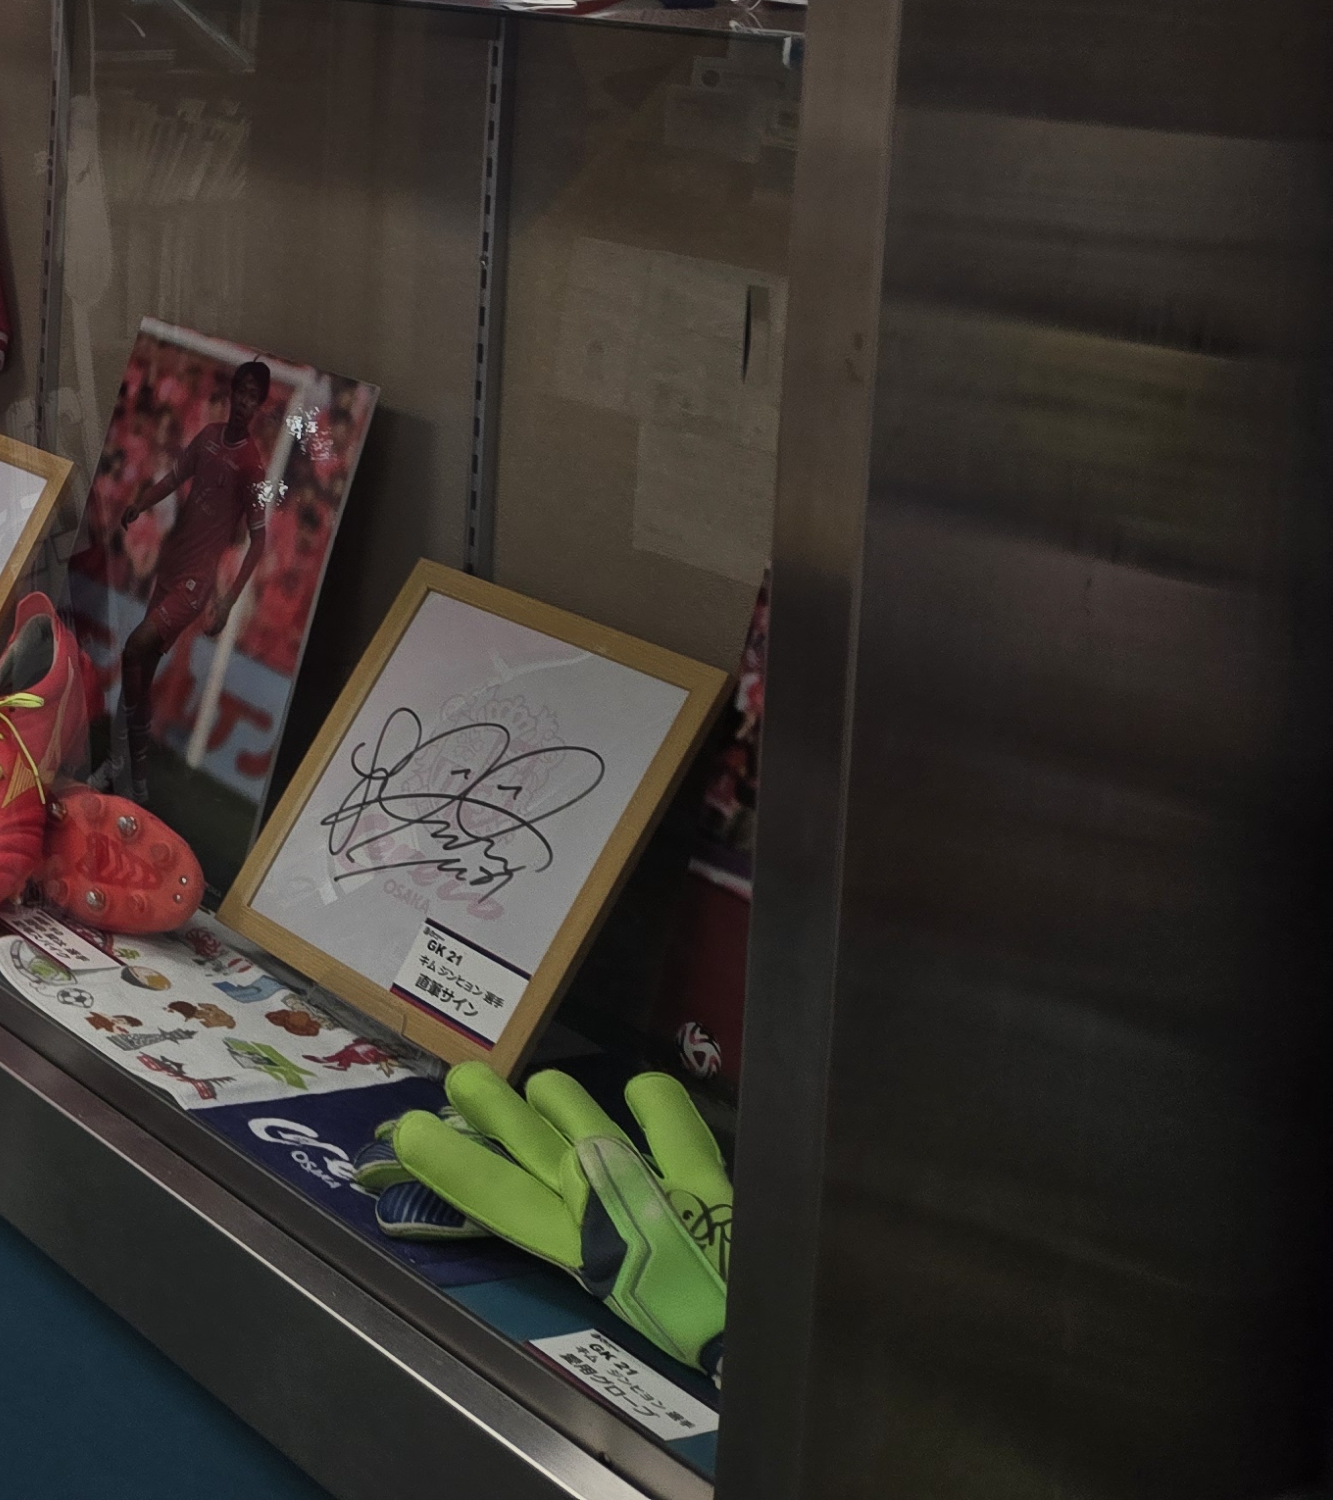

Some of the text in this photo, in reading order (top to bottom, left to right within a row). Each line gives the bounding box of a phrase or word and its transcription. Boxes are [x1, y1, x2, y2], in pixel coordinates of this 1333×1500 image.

[418, 955, 436, 972] キム
[427, 940, 463, 966] GK 21
[415, 973, 478, 1016] 直筆サイン
[576, 1345, 598, 1363] キム
[589, 1343, 638, 1376] GK 21
